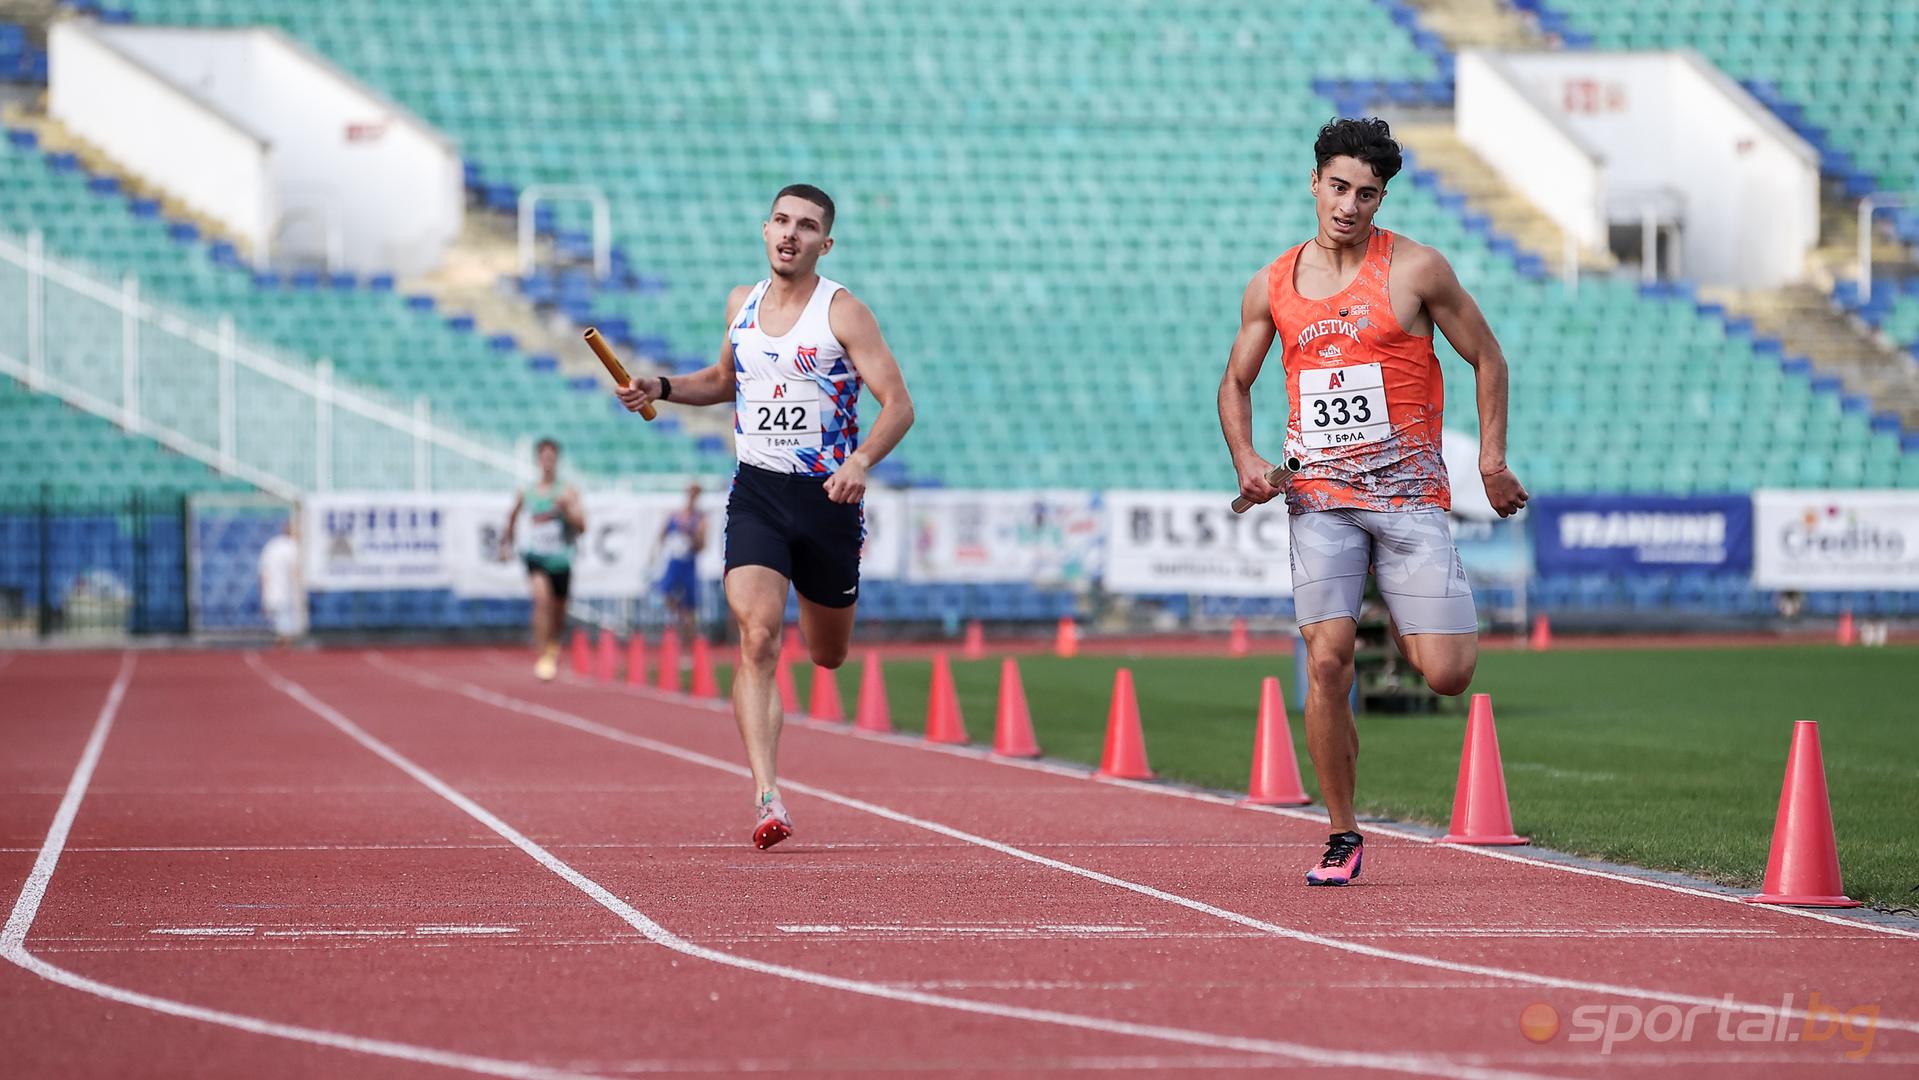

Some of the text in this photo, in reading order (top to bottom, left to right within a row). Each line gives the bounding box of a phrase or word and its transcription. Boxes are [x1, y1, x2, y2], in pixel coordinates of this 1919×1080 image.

[1328, 370, 1345, 390] A1
[773, 383, 787, 399] A1
[758, 407, 807, 431] 242
[1313, 395, 1371, 427] 333
[775, 438, 800, 446] БФЛА
[1335, 432, 1365, 443] БФЛА
